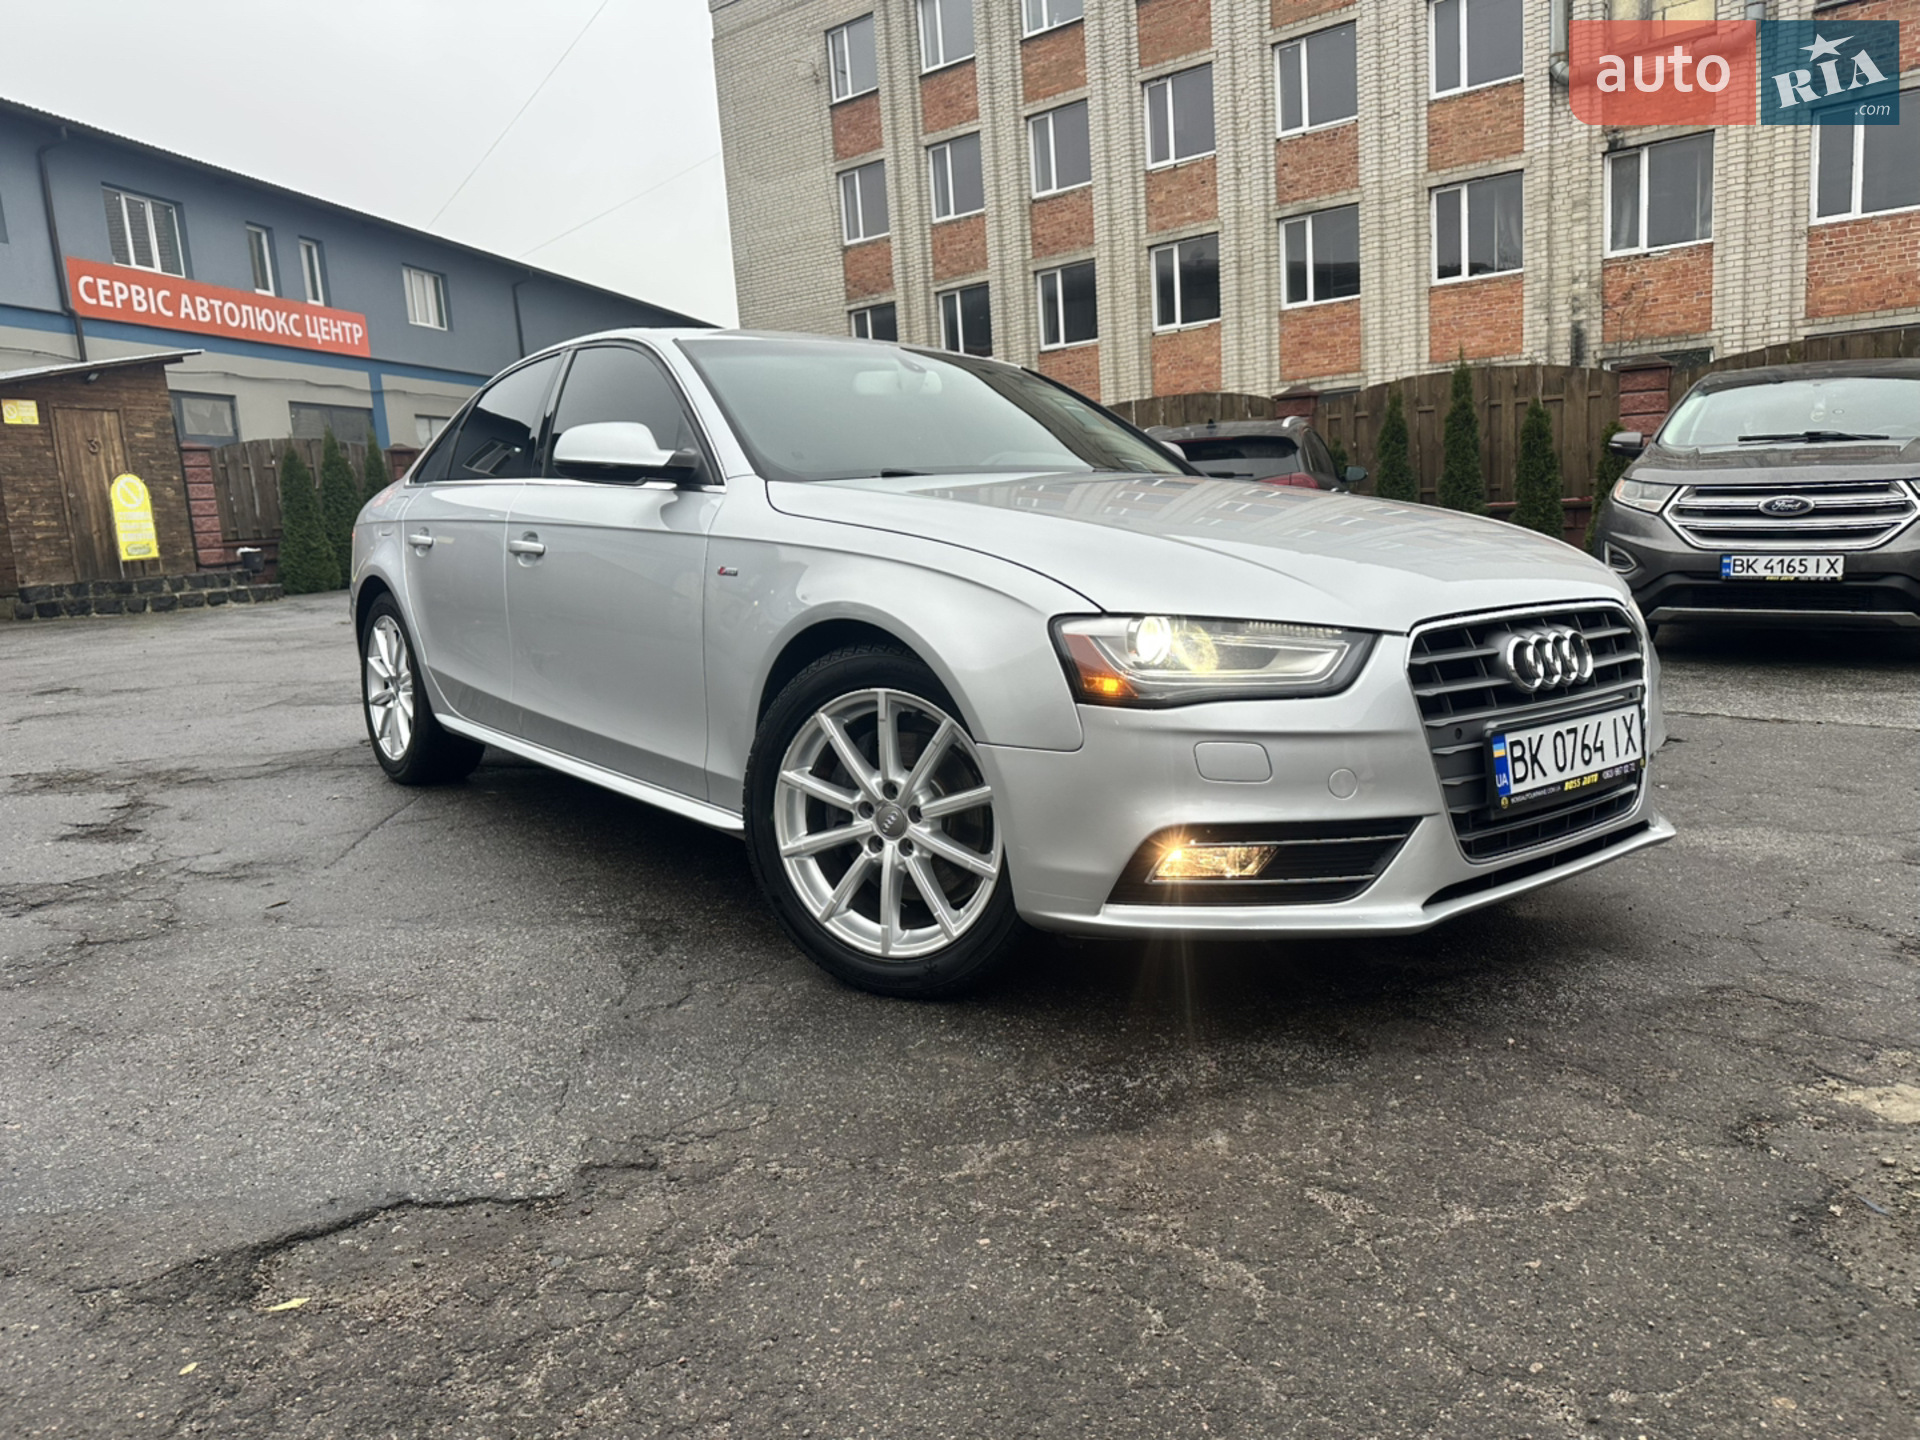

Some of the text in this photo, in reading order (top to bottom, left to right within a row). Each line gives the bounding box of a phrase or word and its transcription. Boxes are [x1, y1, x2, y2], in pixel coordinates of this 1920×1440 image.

[78, 275, 363, 346] СЕРВІС АВТОЛЮКС ЦЕНТР
[1732, 558, 1759, 574] BK
[1763, 558, 1808, 574] 4165
[1508, 713, 1637, 785] BK 0764 IX
[1495, 772, 1509, 788] UA
